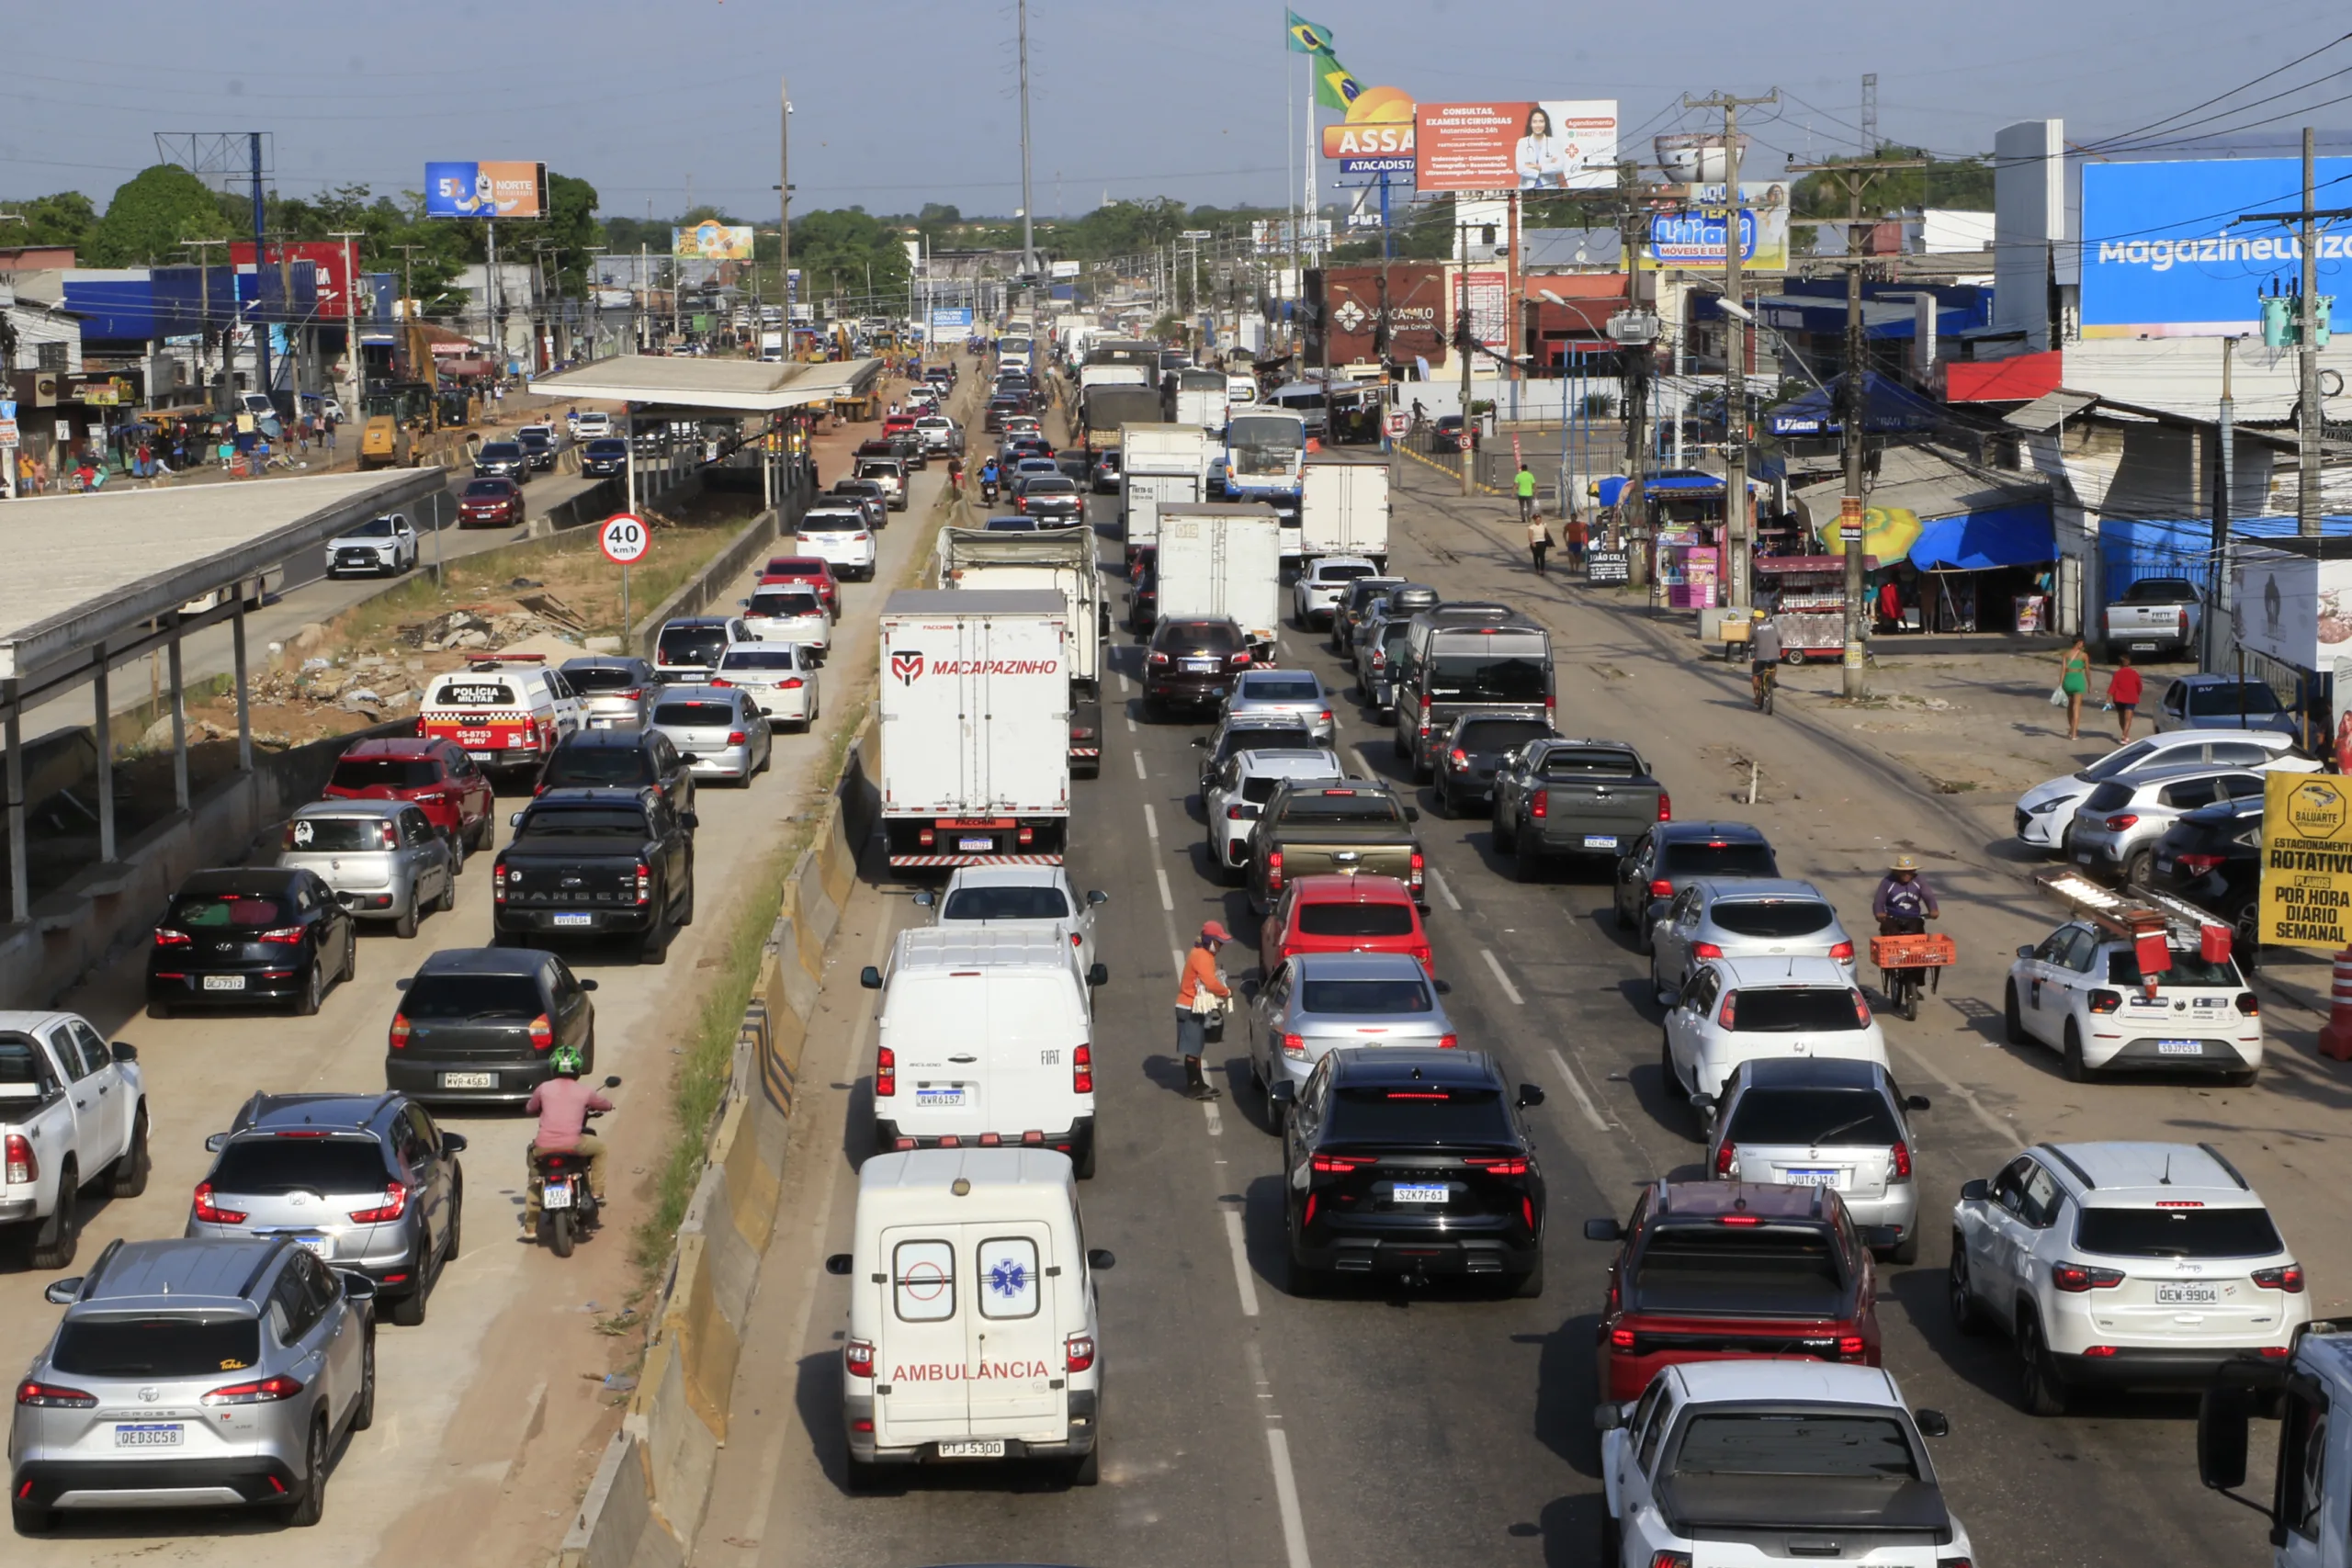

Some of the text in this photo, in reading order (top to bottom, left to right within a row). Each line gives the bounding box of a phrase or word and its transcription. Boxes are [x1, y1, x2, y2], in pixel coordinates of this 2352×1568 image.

[1442, 107, 1495, 116] CONSULTAS,
[1568, 118, 1613, 127] Agendamento
[496, 180, 532, 190] NORTE
[1660, 246, 1698, 255] MÓVEIS
[608, 525, 639, 543] 40
[613, 546, 637, 555] km/h
[932, 660, 1057, 675] MACAPAZINHO
[453, 685, 499, 696] POLÍCIA
[2295, 811, 2337, 824] BALUARTE
[2270, 850, 2352, 874] ROTATIV
[2295, 875, 2331, 888] PLANOS
[510, 892, 633, 900] RANGER
[2275, 886, 2350, 908] POR HORA
[2286, 901, 2337, 924] DIÁRIO
[2276, 921, 2347, 942] SEMANAL
[1041, 1050, 1060, 1066] FIAT
[1398, 1190, 1443, 1201] SZK7F61
[891, 1359, 1049, 1382] AMBULÂNCIA
[121, 1430, 176, 1445] QED3C58
